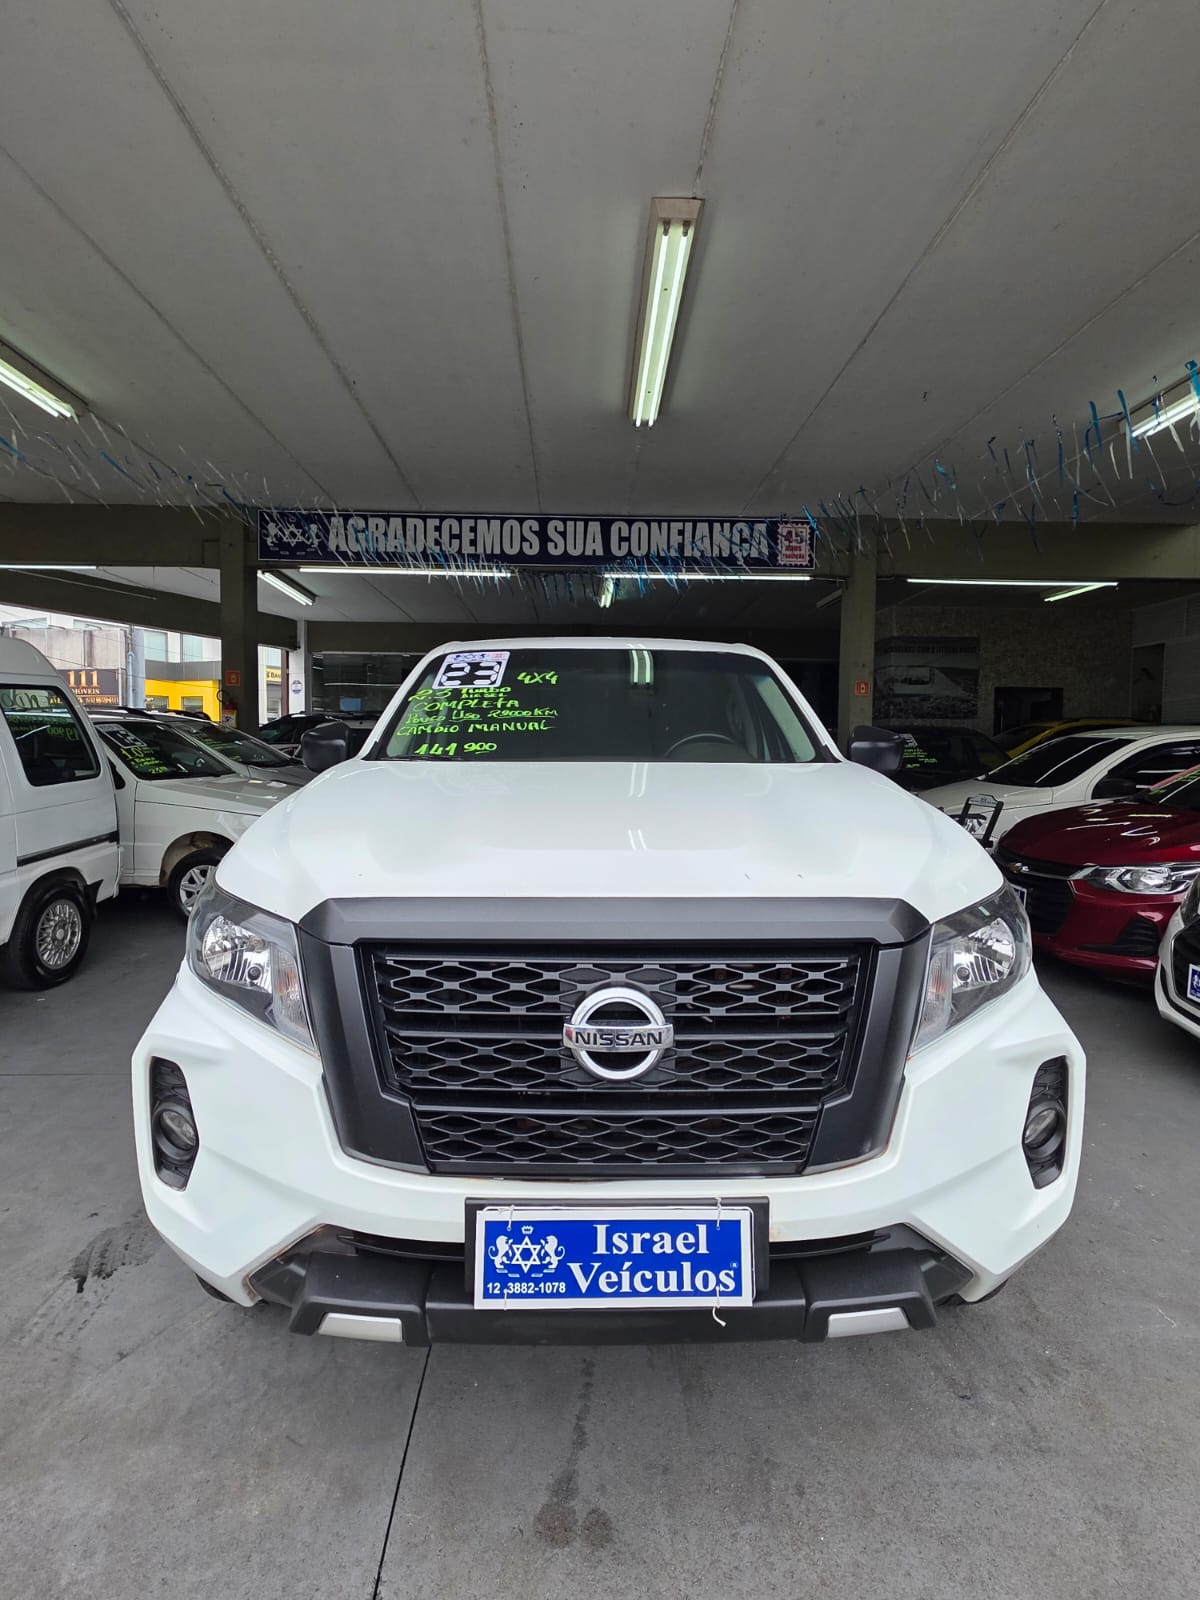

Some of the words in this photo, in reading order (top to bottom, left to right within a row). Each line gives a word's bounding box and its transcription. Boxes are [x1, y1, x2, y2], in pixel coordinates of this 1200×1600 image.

[327, 516, 540, 557] AGRADECEMOS
[547, 518, 604, 557] SUA
[784, 529, 805, 544] 45
[67, 670, 100, 688] 111
[440, 660, 500, 686] 23
[413, 697, 519, 712] COMPLETA
[467, 719, 555, 733] MANUAL
[575, 1031, 662, 1046] NISSAN
[592, 1223, 710, 1255] Israel
[567, 1261, 736, 1293] Veículos
[486, 1282, 501, 1294] 12
[506, 1281, 567, 1294] 3882-1078
